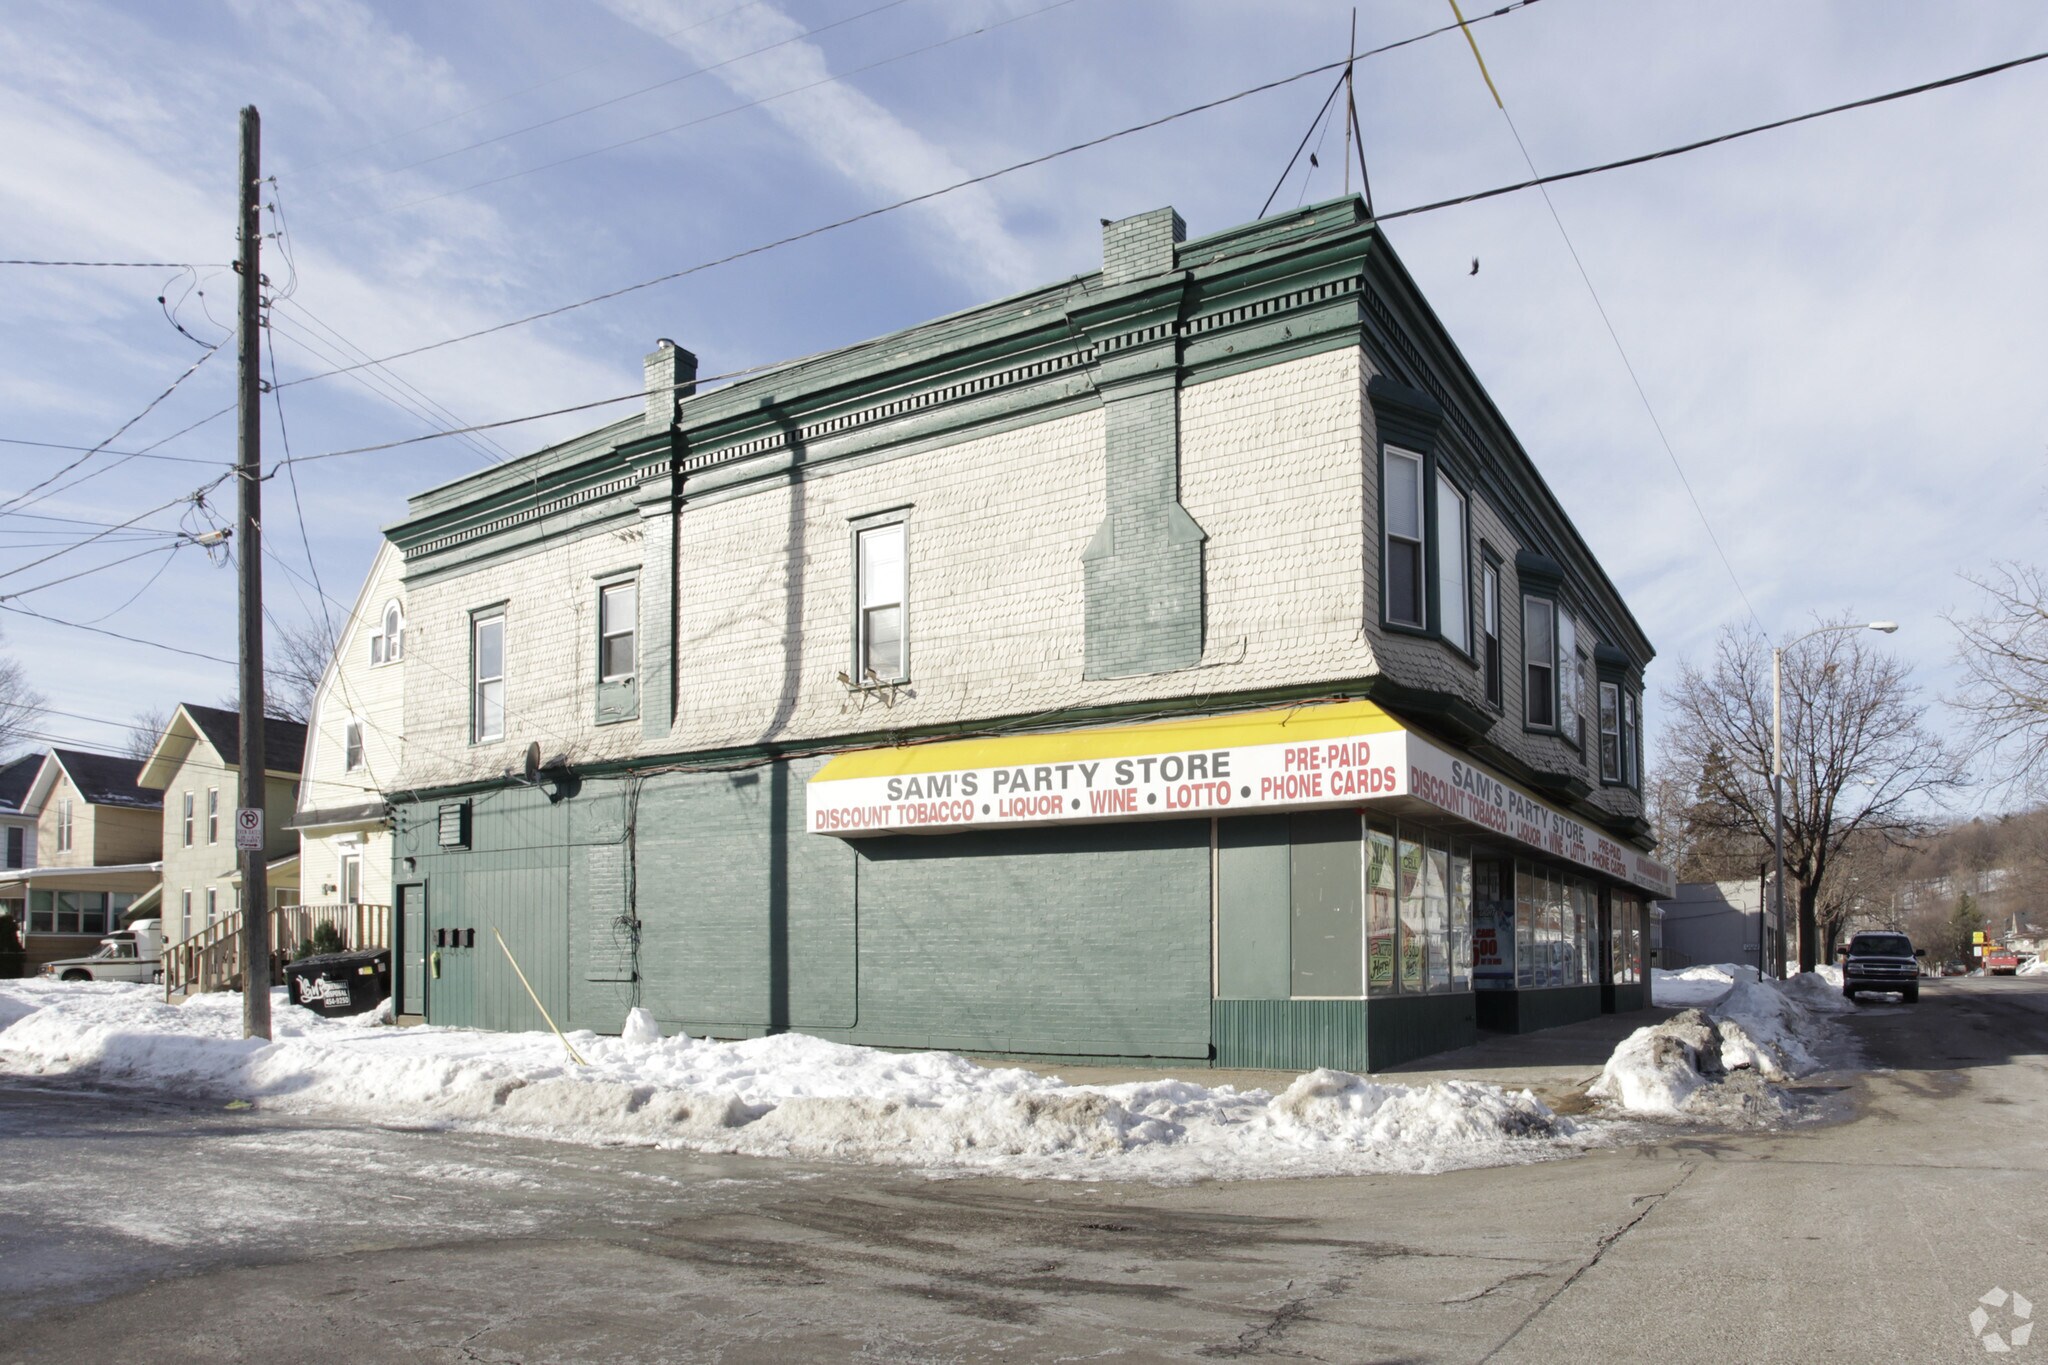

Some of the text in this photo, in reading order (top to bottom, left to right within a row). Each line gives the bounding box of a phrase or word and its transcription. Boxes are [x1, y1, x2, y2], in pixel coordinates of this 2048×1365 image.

[887, 751, 1231, 801] SAM'S PARTY STORE
[1284, 741, 1371, 772] PRE-PAID
[1261, 766, 1396, 800] PHONE CARDS
[1451, 760, 1584, 845] SAM'S PARTY STORE
[815, 780, 1232, 830] DISCOUNT TOBACCO LIQUOR WINE LOTTO
[1411, 765, 1586, 863] DISCOUNT TOBACCO LIQUOR WINE LOTTO
[1592, 851, 1610, 871] PHONE
[1611, 859, 1627, 878] CARDS
[1598, 838, 1621, 861] PRE-PAID
